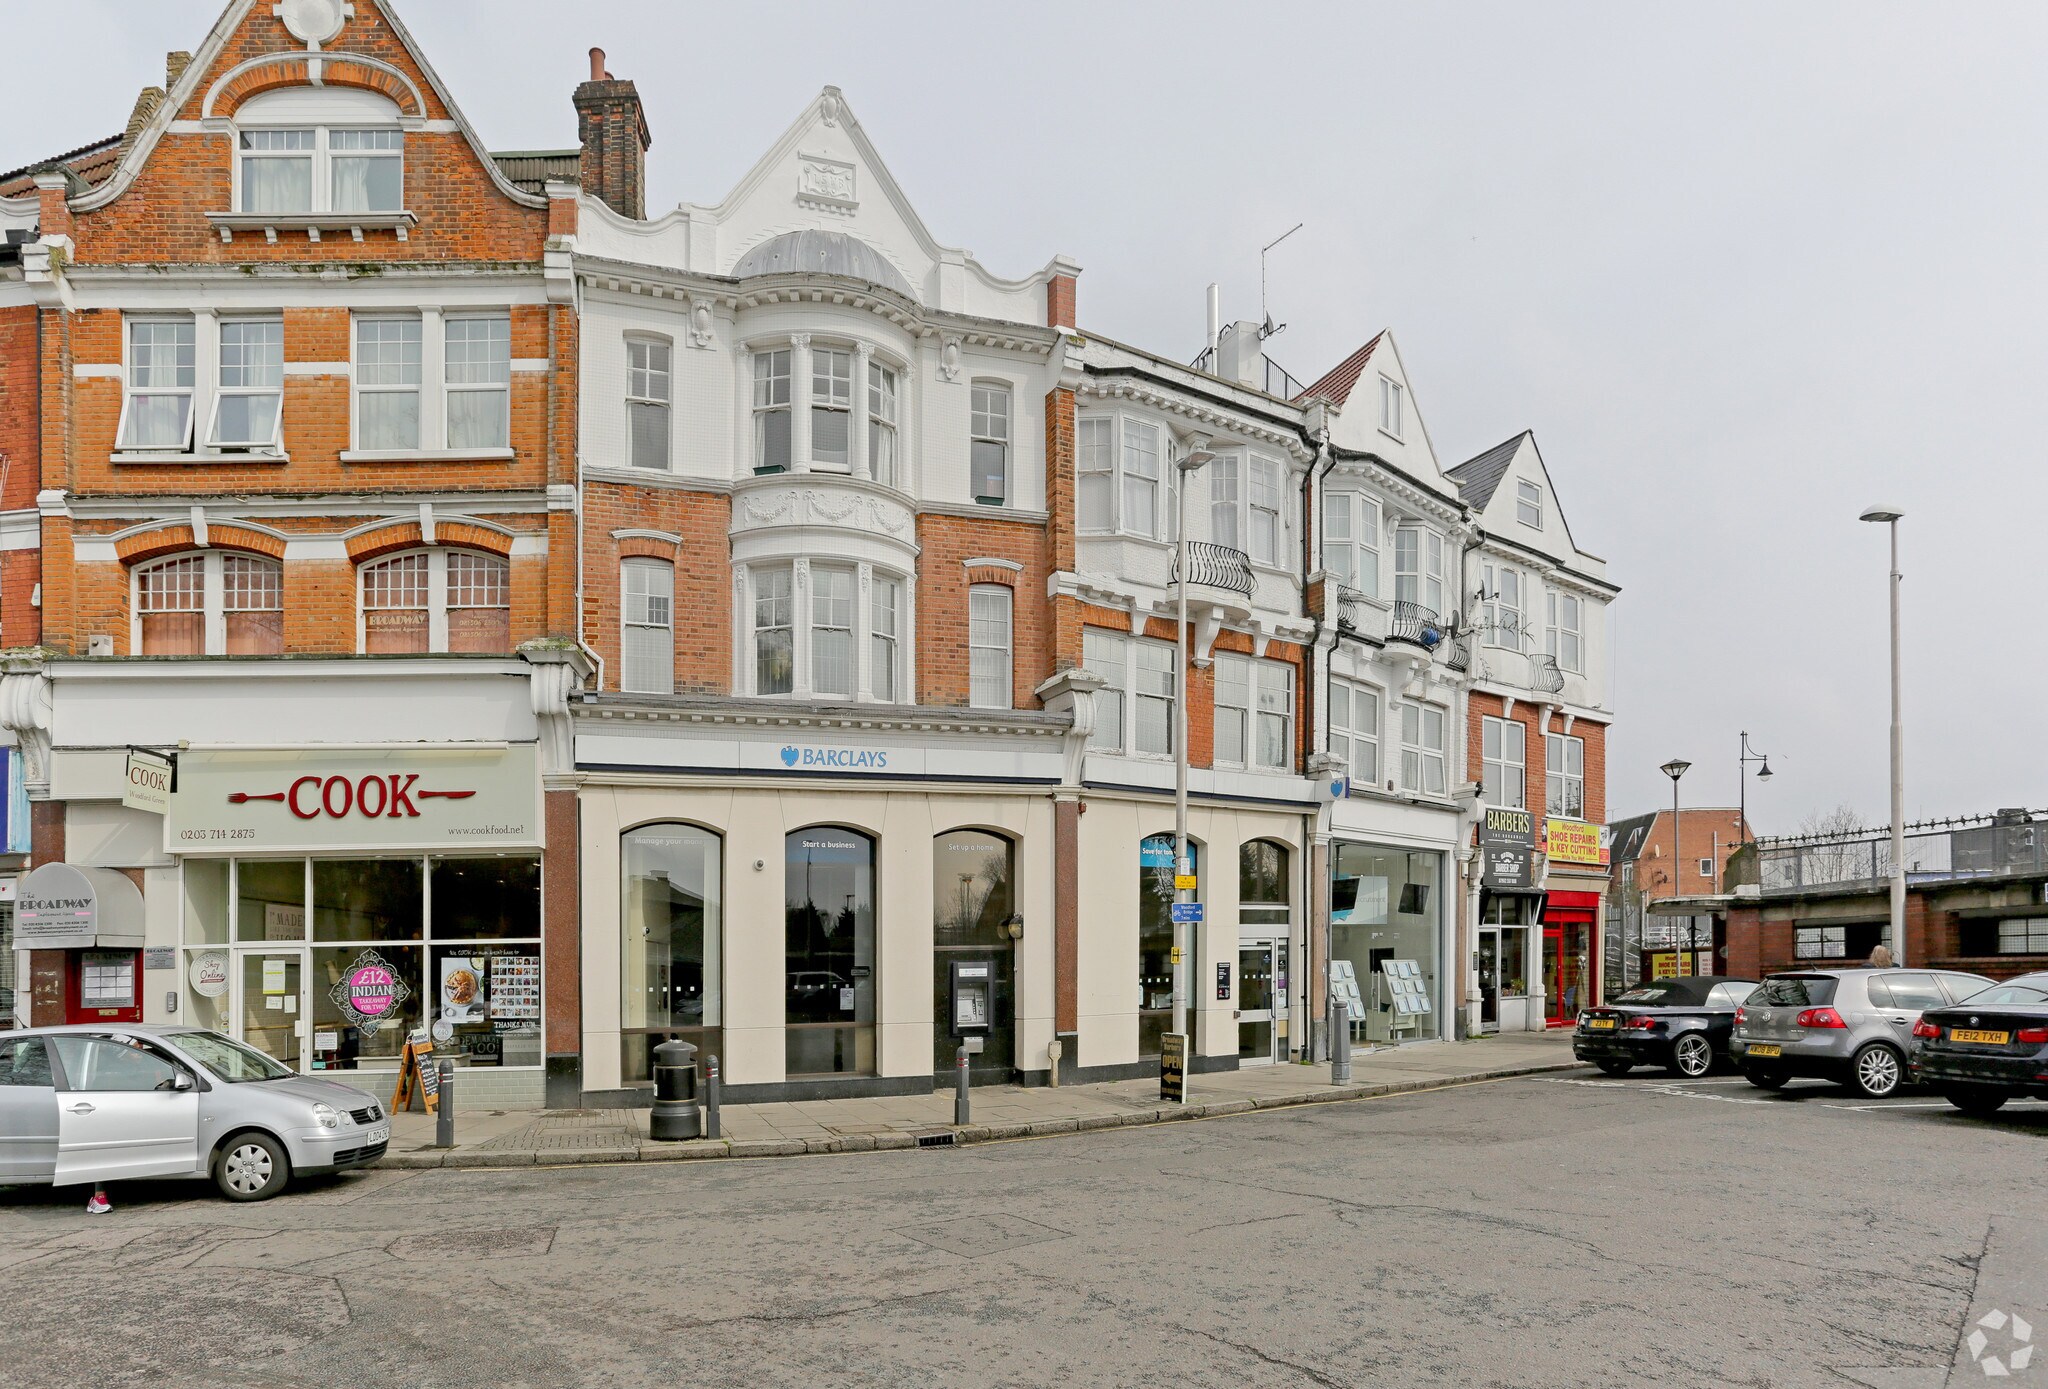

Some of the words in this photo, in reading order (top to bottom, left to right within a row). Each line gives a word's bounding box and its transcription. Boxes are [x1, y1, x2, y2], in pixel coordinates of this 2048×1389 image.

[369, 615, 425, 625] BROADWAY
[803, 749, 887, 767] BARCLAYS
[130, 767, 167, 791] COOK
[152, 795, 165, 804] Green
[288, 774, 420, 819] COOK
[1487, 810, 1530, 833] BARBERS
[1562, 822, 1584, 832] Woodford
[181, 829, 206, 840] 0203
[210, 829, 226, 839] 714
[231, 829, 255, 839] 2875
[448, 824, 524, 835] www.cookfood.net
[635, 837, 663, 845] Manage
[1550, 831, 1567, 842] SHOE
[1570, 833, 1596, 845] REPAIRS
[1550, 843, 1556, 851] &
[1557, 843, 1568, 853] KEY
[1571, 845, 1596, 855] CUTTING
[1496, 863, 1509, 872] BARBER
[1510, 864, 1519, 872] SHOP
[20, 898, 92, 910] BROADWAY
[200, 969, 226, 979] Online
[359, 971, 385, 984] £12
[352, 985, 391, 997] INDIAN
[1957, 1031, 1979, 1040] FE12
[1982, 1032, 2001, 1041] TXH
[1163, 1055, 1182, 1069] OPEN
